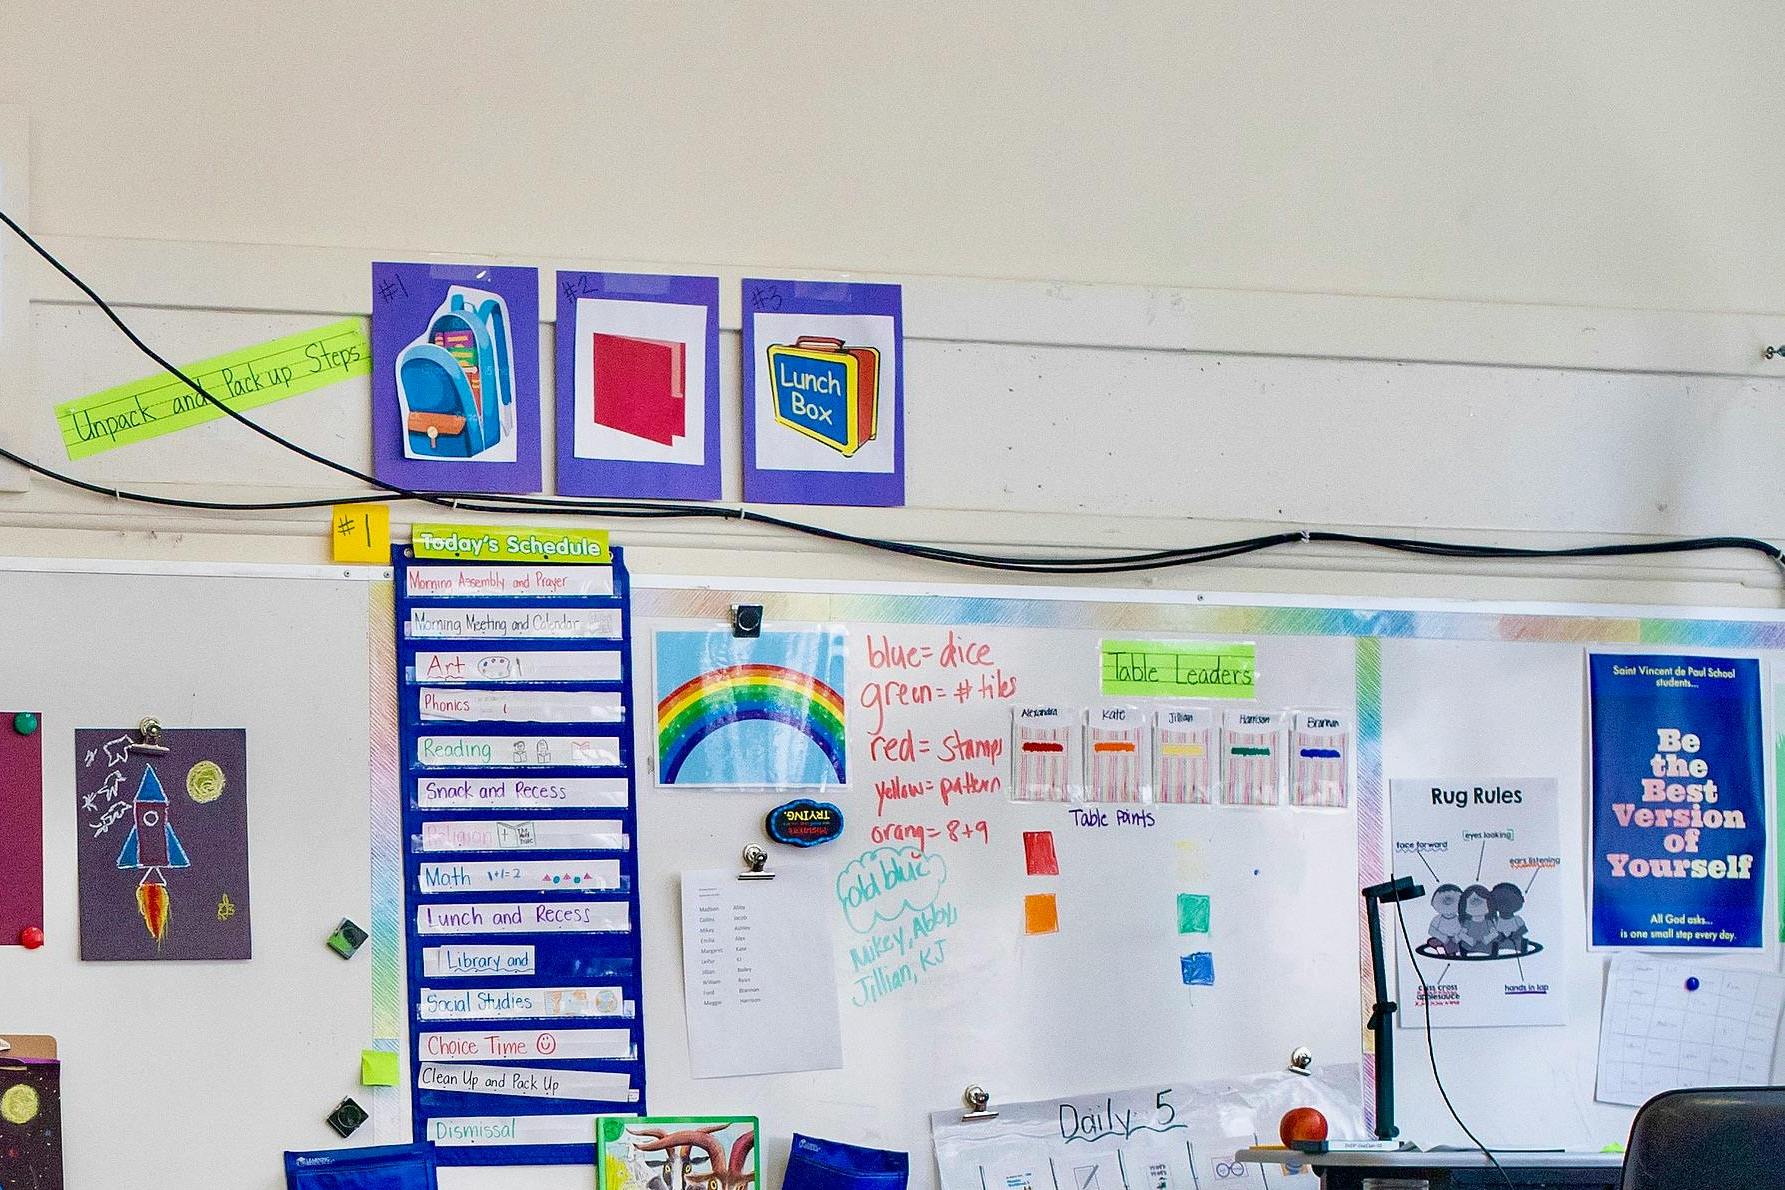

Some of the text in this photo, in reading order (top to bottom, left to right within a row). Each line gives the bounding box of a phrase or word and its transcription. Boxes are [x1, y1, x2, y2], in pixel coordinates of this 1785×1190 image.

[377, 273, 410, 304] #1
[563, 275, 599, 304] #2
[72, 394, 157, 442] Unpack
[172, 377, 208, 416] and
[304, 340, 362, 374] Steps
[779, 362, 842, 396] Lunch
[791, 391, 833, 426] Box
[420, 532, 601, 557] Today's Schedule
[458, 571, 505, 591] Assembly
[513, 573, 530, 588] and
[535, 571, 568, 592] Prayer
[414, 611, 462, 635] Morning
[466, 613, 507, 636] Meeting
[511, 614, 530, 631] and
[939, 629, 995, 668] dice
[427, 654, 466, 677] Art
[1108, 651, 1254, 686] Table Leaders
[1613, 665, 1736, 679] Saint Vincent de Paul School
[978, 669, 1017, 700] tiles
[424, 693, 470, 713] Phonics
[1101, 708, 1127, 721] Kate
[1168, 712, 1194, 724] Jillian
[423, 738, 492, 763] Reading
[1657, 728, 1701, 753] Be
[1650, 753, 1708, 778] the
[425, 781, 567, 800] Snack and Recess
[1431, 786, 1523, 808] Rug Rules
[1641, 778, 1718, 803] Best
[783, 810, 831, 821] TRYING.
[1069, 809, 1109, 828] Table
[1612, 803, 1746, 829] Version
[1396, 841, 1448, 849] face forward
[1465, 830, 1512, 840] eyes looking
[1664, 828, 1701, 853] of
[1528, 857, 1561, 865] listening
[1606, 853, 1754, 879] Yourself
[425, 865, 471, 887] Math
[879, 857, 931, 890] blue
[427, 904, 591, 928] Lunch and Recess
[1650, 914, 1663, 925] All
[1665, 914, 1685, 925] God
[1620, 929, 1736, 942] is one small step every day.
[446, 949, 529, 971] Library and
[920, 938, 947, 973] KJ
[1536, 984, 1549, 993] lap
[427, 989, 533, 1013] Social Studies
[427, 1034, 528, 1057] Choice Time
[422, 1066, 560, 1094] Clean Up and Pack Up
[1059, 1091, 1176, 1140] Daily 5
[436, 1117, 516, 1140] Dismissal
